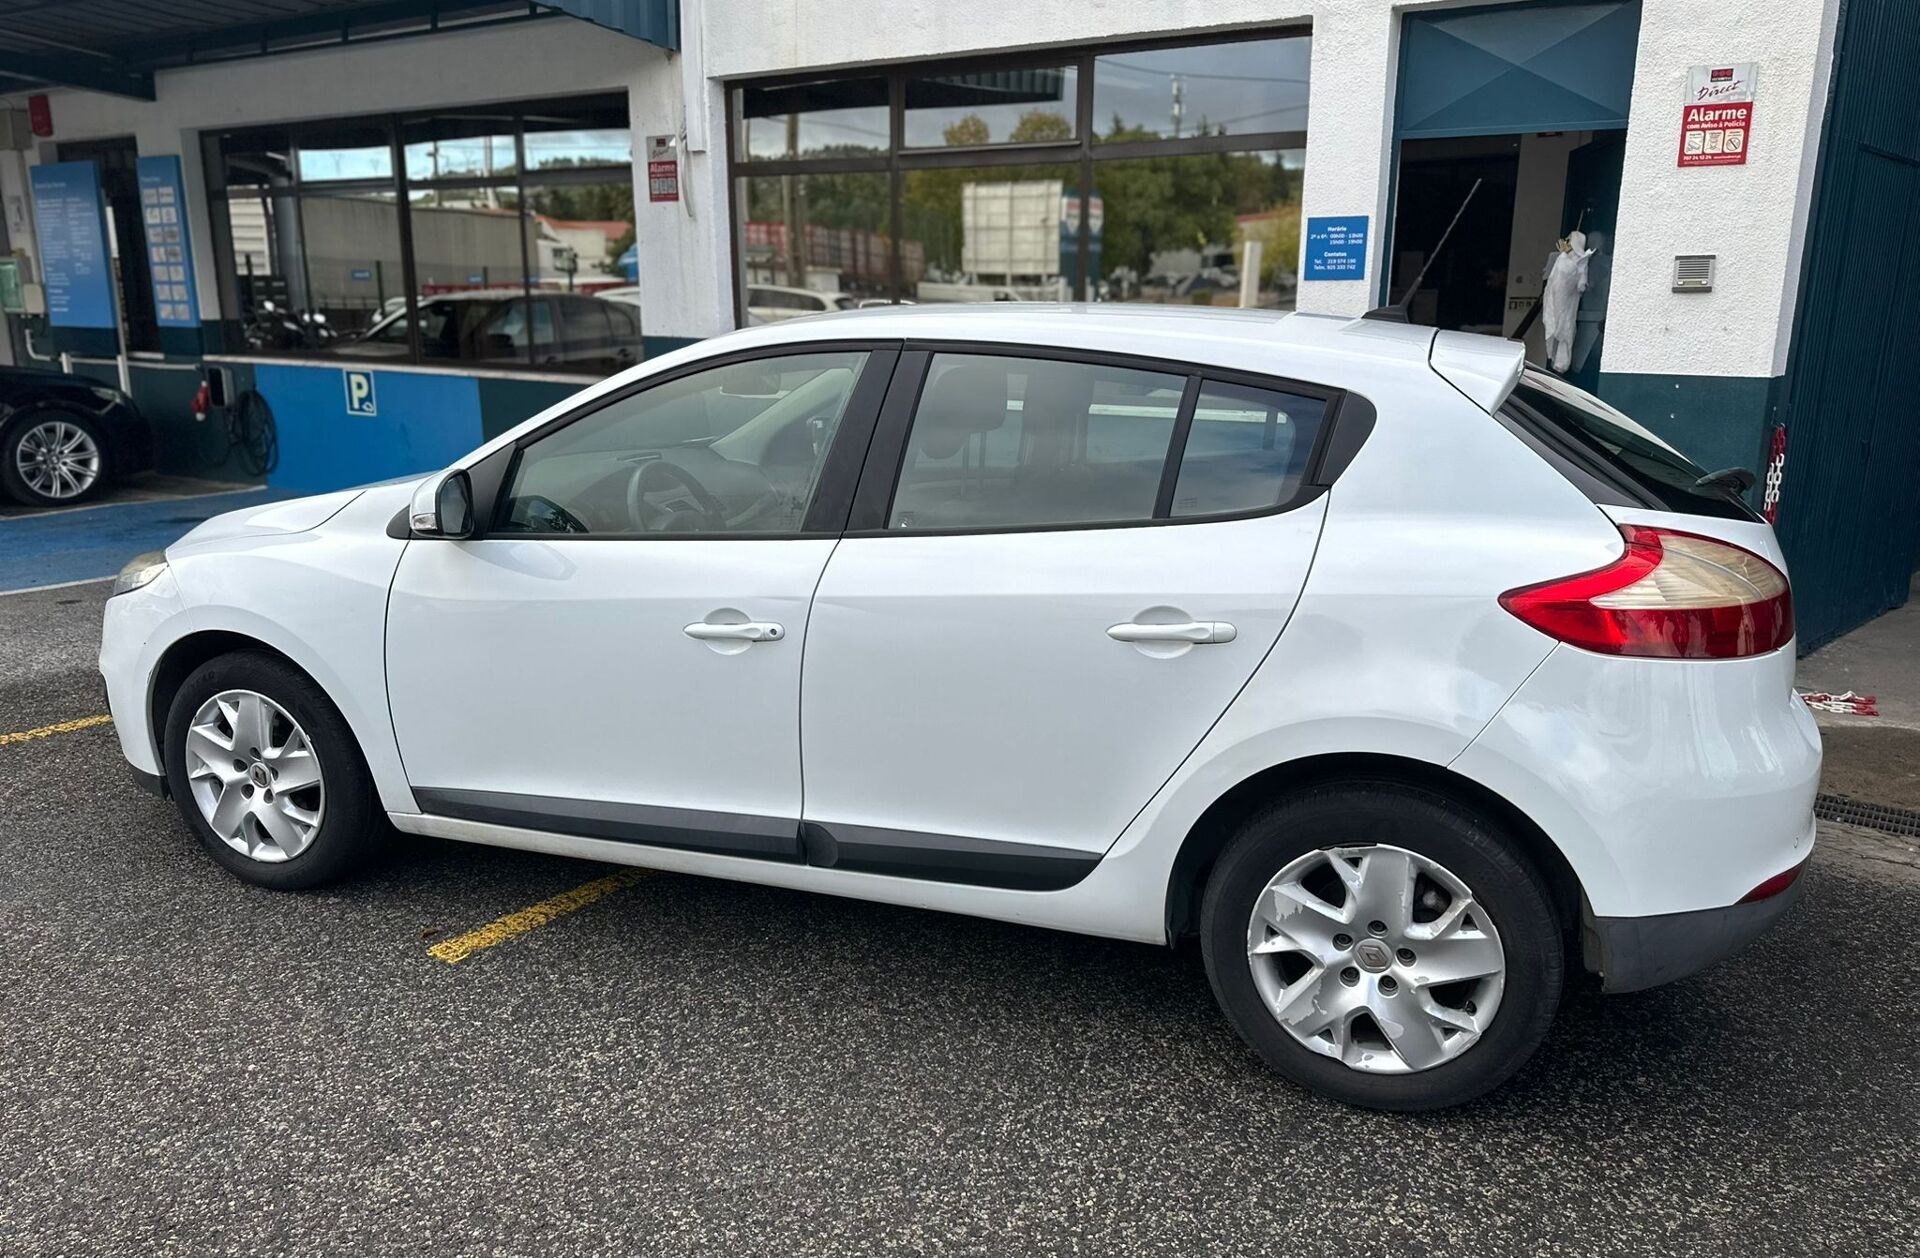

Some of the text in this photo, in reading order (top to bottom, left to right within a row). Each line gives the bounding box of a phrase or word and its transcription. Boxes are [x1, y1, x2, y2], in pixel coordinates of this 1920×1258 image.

[1697, 80, 1743, 101] Direct
[1687, 107, 1747, 122] Alarme
[1700, 121, 1718, 129] Aviso
[350, 373, 369, 409] P
